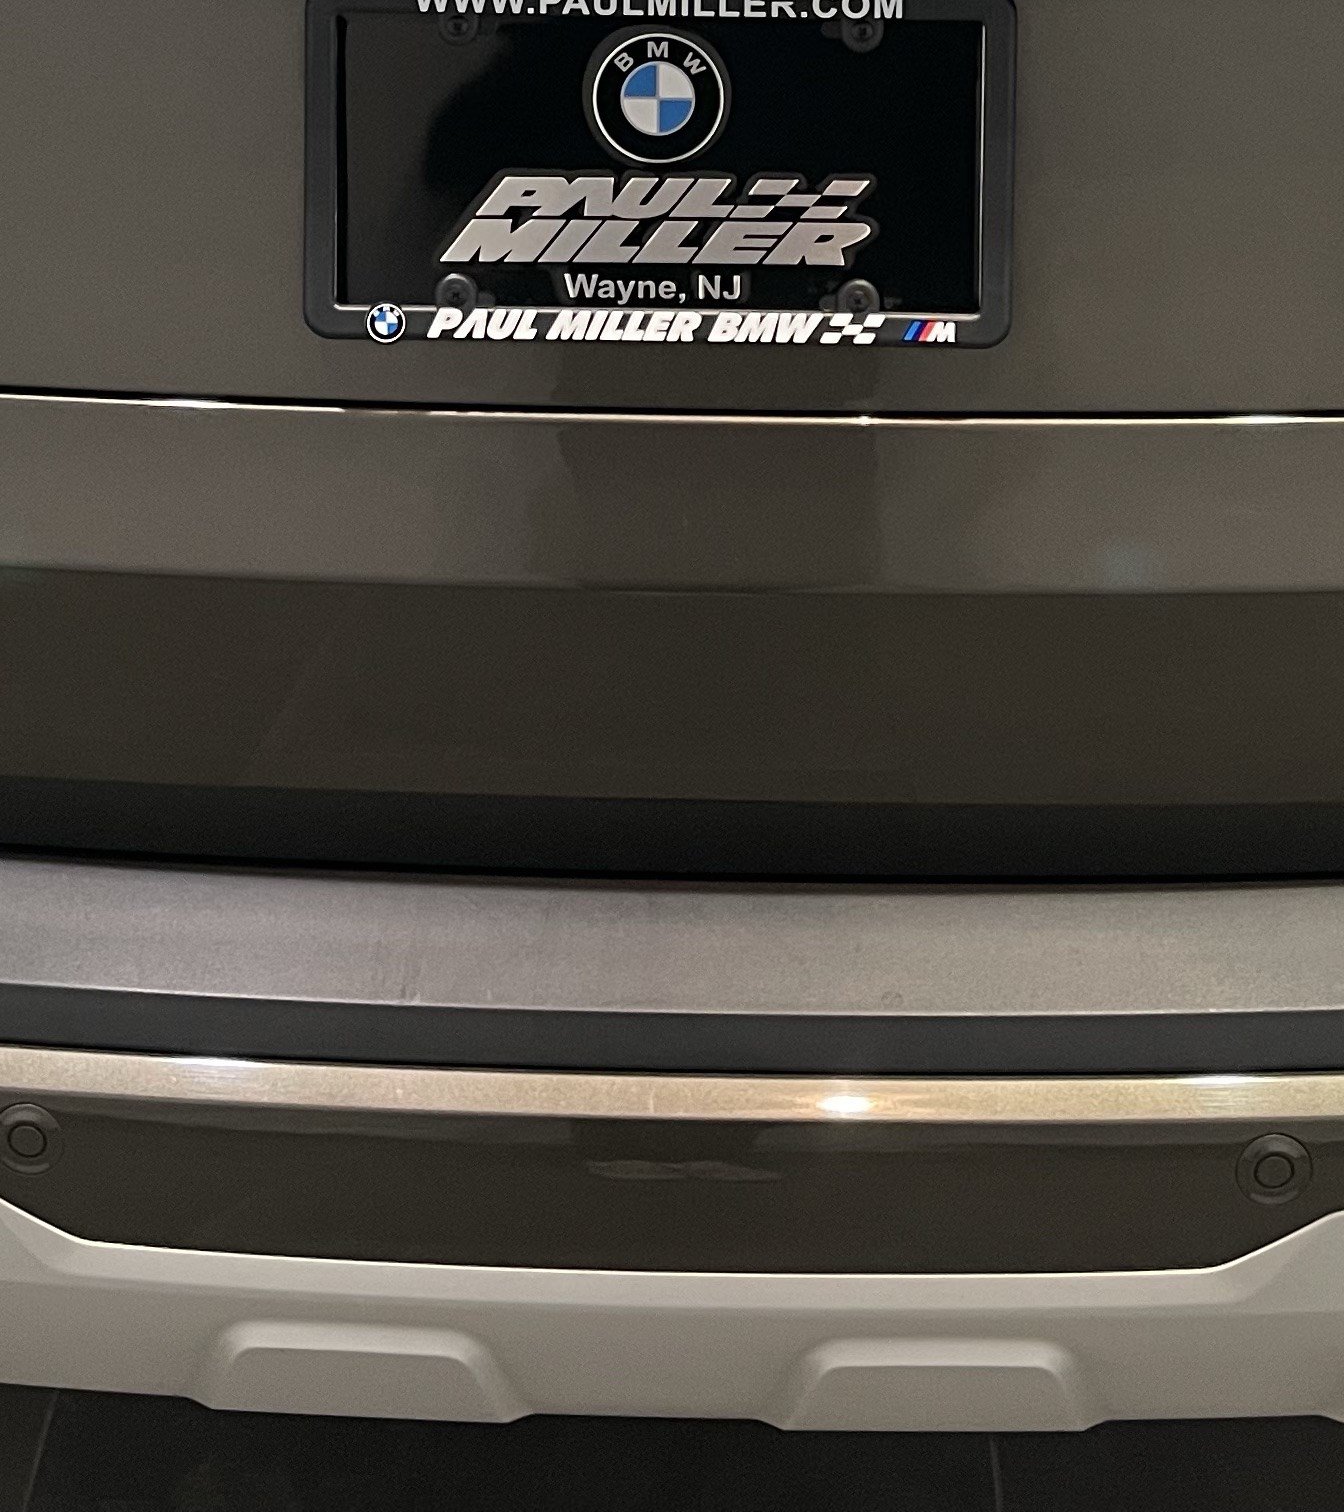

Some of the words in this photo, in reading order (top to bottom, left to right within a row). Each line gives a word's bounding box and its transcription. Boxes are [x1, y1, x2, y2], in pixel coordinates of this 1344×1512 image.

[613, 41, 707, 76] BMW
[476, 176, 737, 219] PAUL
[440, 219, 871, 266] MILLER
[564, 273, 686, 304] Wayne,
[697, 274, 742, 300] NJ
[426, 307, 538, 340] PAUL
[545, 309, 703, 342] MILLER
[707, 312, 825, 343] BMW
